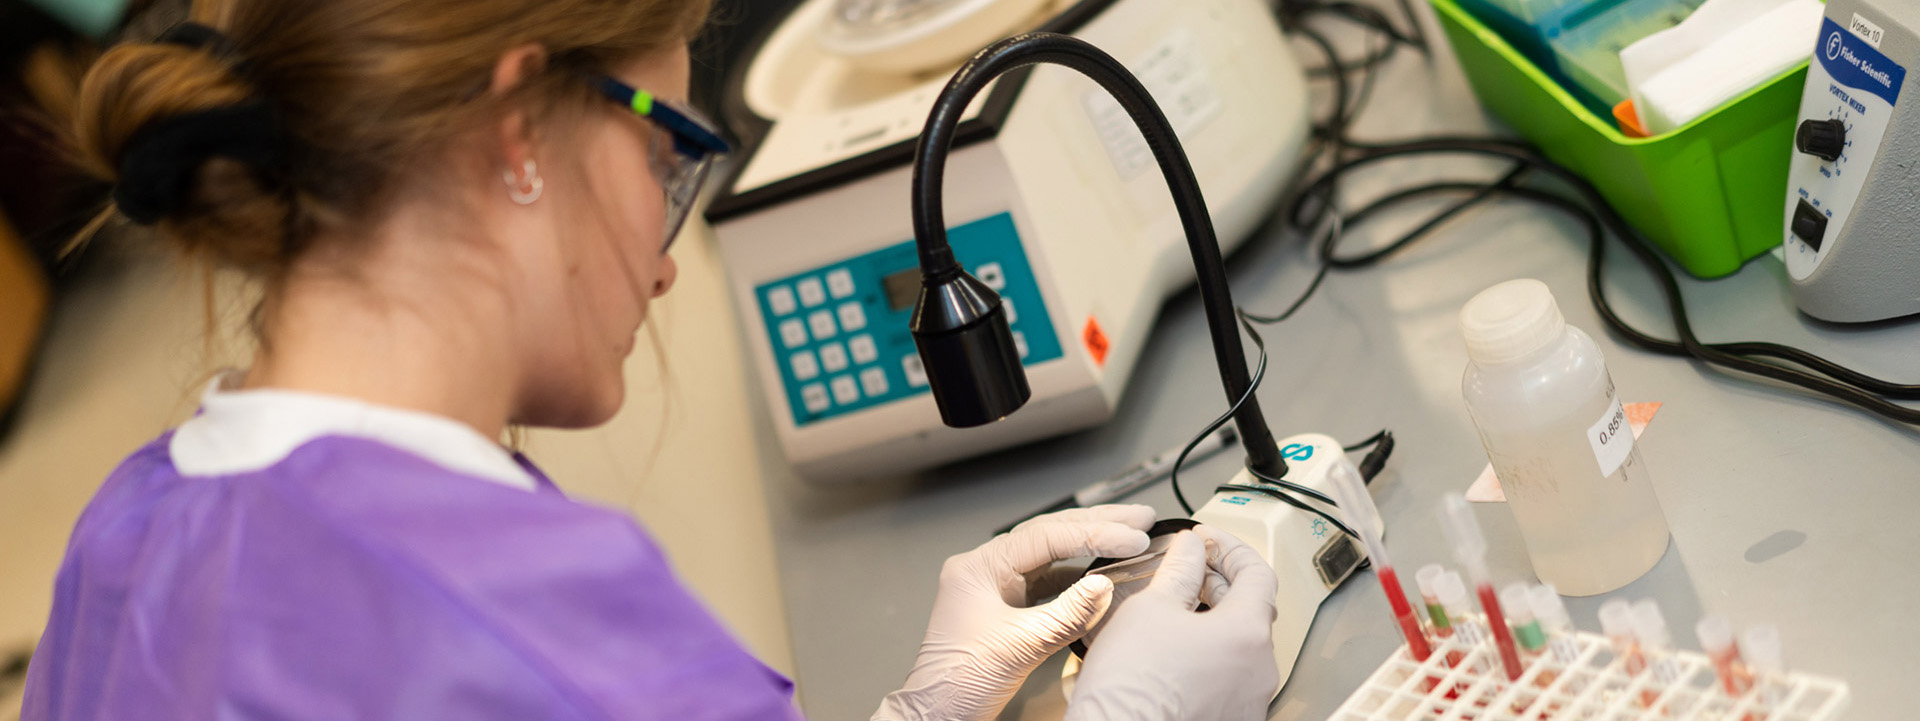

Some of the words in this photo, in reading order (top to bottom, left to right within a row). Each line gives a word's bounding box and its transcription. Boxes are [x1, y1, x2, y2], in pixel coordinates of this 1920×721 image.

[1852, 17, 1870, 37] Vortex
[1871, 30, 1880, 43] 10
[1841, 46, 1861, 68] Fisher
[1860, 60, 1892, 88] Scientific
[1829, 83, 1850, 103] VORTEX
[1848, 97, 1866, 115] MIXER
